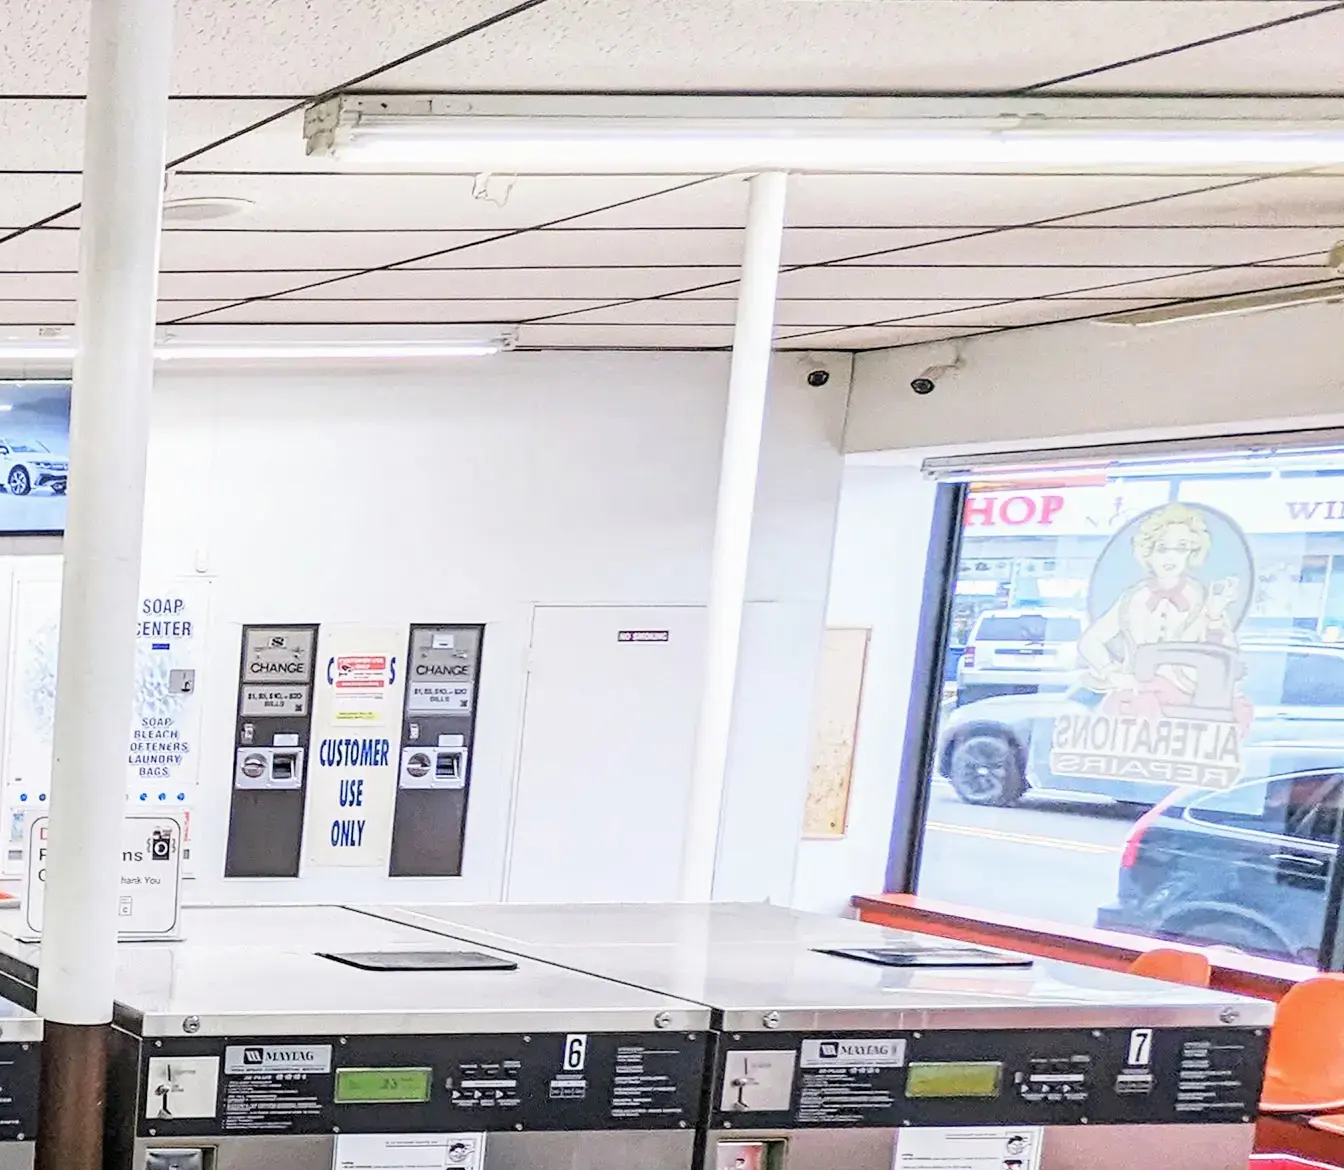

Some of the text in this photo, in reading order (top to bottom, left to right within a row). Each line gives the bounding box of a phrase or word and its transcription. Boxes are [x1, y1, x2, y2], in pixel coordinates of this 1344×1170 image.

[142, 598, 184, 614] SOAP
[250, 662, 305, 674] CHANGE
[416, 664, 469, 676] CHANGE
[141, 717, 172, 727] SOAP
[134, 730, 179, 739] BLEACH
[130, 741, 189, 752] OFTENERS
[319, 738, 389, 767] CUSTOMER
[128, 754, 182, 764] LAUNDRY
[139, 766, 169, 777] BAGS
[339, 779, 363, 807] USE
[331, 820, 366, 847] ONLY
[120, 876, 161, 885] hank You
[568, 1038, 583, 1068] 6
[840, 1045, 889, 1055] MAYTAG
[1135, 1033, 1149, 1063] 7
[265, 1051, 314, 1061] MAYTAG
